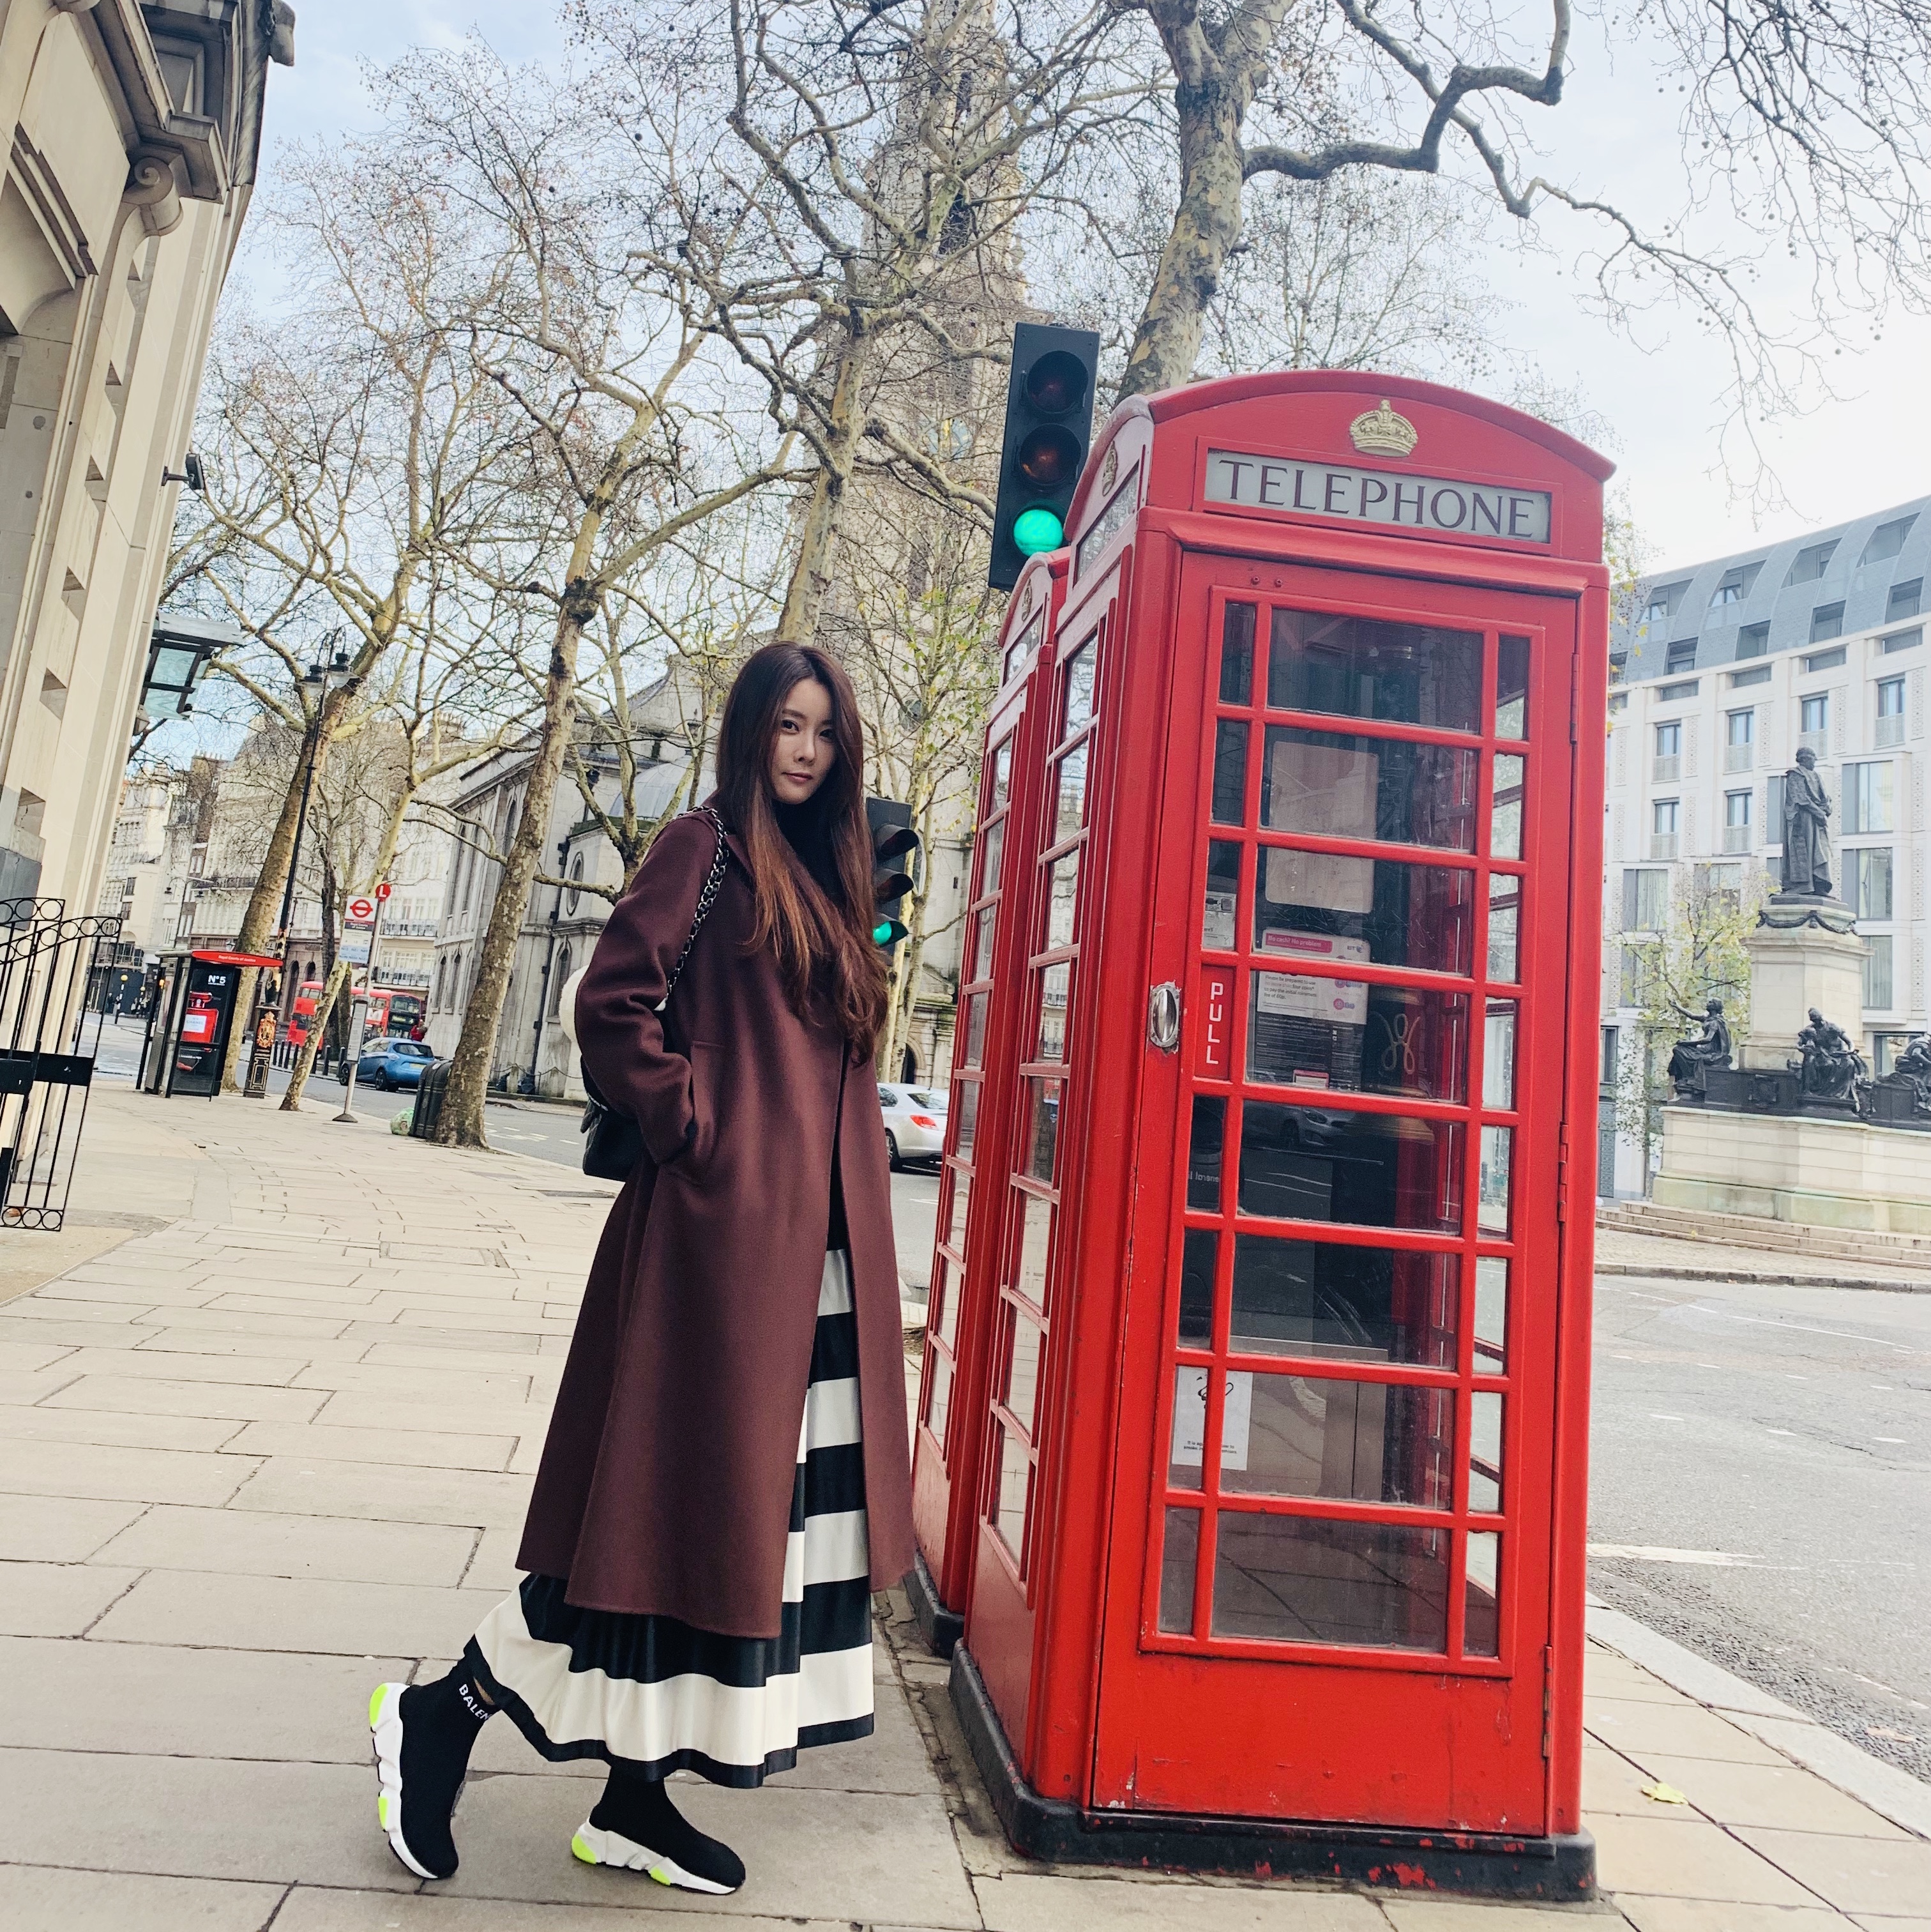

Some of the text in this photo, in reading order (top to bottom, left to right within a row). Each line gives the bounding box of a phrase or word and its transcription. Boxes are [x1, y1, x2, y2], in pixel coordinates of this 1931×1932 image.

[1218, 459, 1534, 538] TELEPHONE
[379, 885, 386, 897] L
[1206, 982, 1223, 1065] PULL
